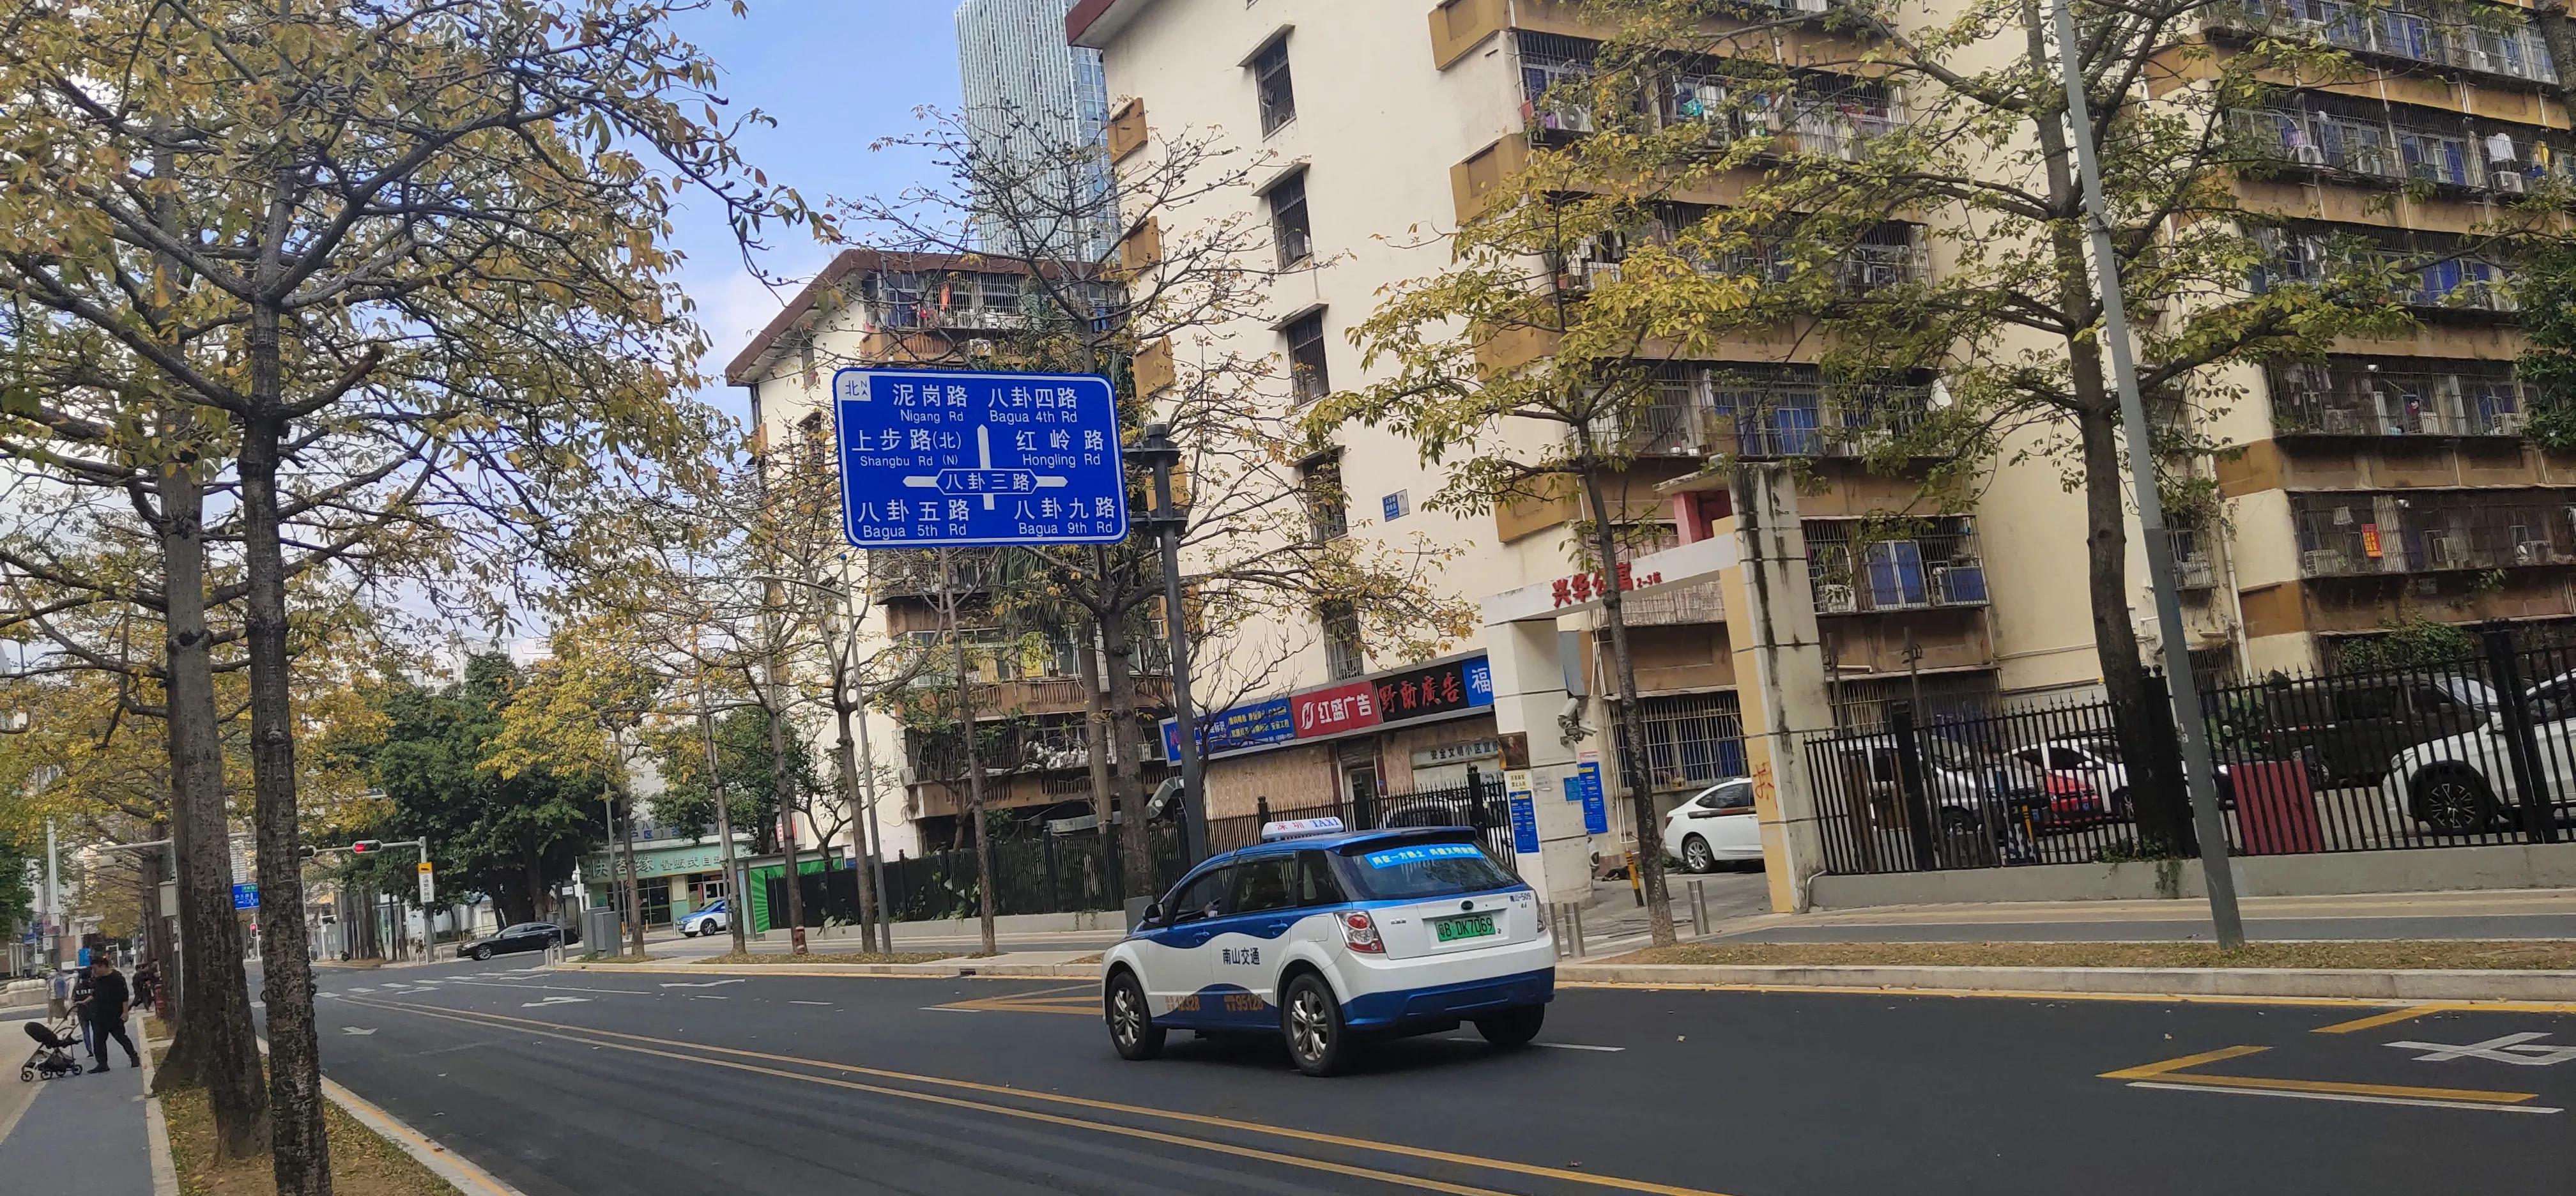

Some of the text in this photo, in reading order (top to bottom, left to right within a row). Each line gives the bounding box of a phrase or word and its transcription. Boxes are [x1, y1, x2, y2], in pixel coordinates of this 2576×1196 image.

[845, 380, 859, 396] 北
[893, 383, 969, 408] 泥岗路
[988, 386, 1078, 410] 八卦四路
[901, 410, 963, 424] Nigang Rd
[990, 410, 1078, 425] Bagua 4th Rd
[1016, 429, 1103, 452] 红岭路
[860, 454, 958, 468] Shangbu Rd (N)
[1023, 454, 1101, 468] Hongling Rd
[946, 473, 1030, 492] 八卦三路
[858, 498, 970, 523] 八卦五路
[1014, 496, 1116, 520] 八卦九路
[864, 525, 967, 540] Bagua 5th Rd
[1019, 522, 1113, 537] Bagua 9th Rd
[1317, 693, 1372, 724] 红盛广告
[1310, 818, 1339, 827] TAXI
[1222, 947, 1261, 965] 南山交通
